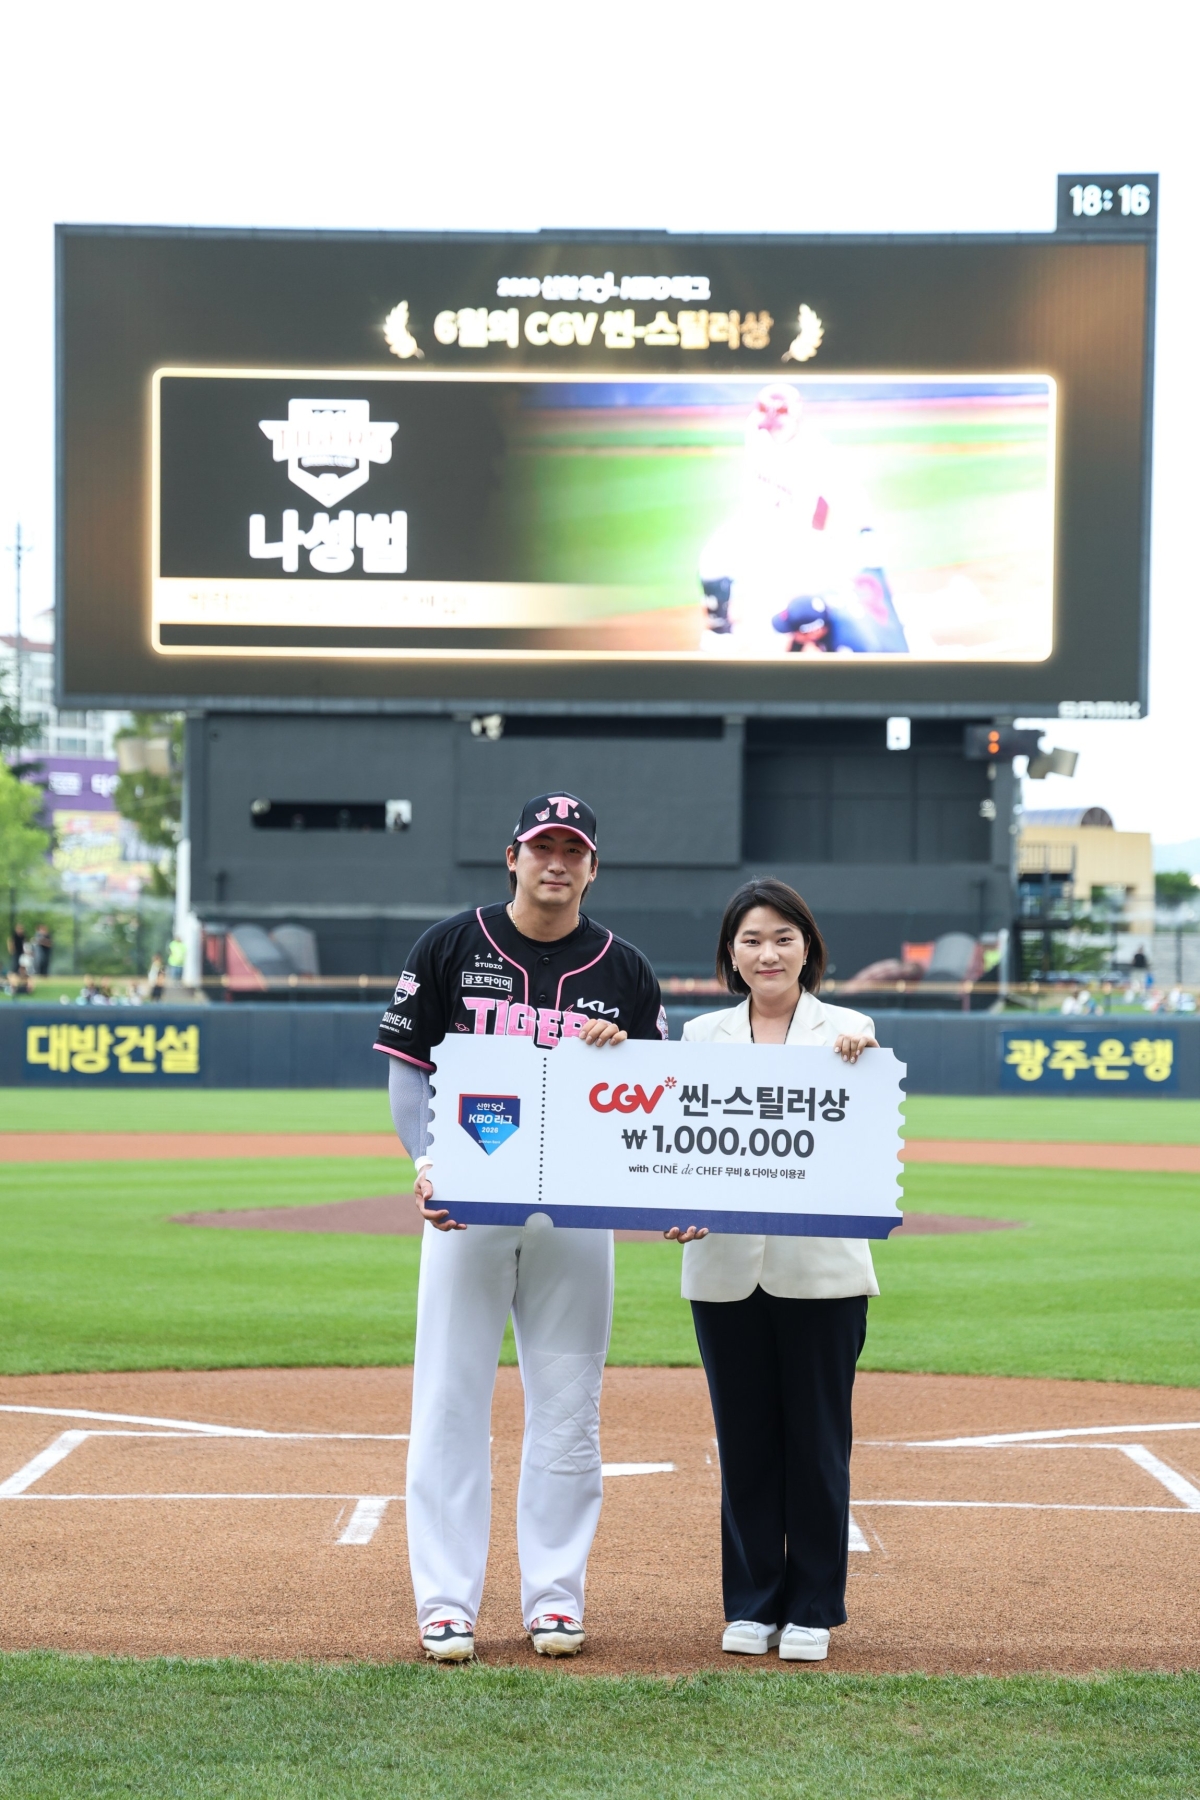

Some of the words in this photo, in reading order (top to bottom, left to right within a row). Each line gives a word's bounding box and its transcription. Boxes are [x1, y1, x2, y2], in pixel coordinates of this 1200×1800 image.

[1069, 184, 1151, 216] 18:16
[524, 310, 599, 346] CGV
[248, 508, 408, 574] 나성범
[463, 974, 511, 990] 금호타이어
[474, 961, 503, 970] STUDIO
[462, 996, 612, 1049] TIGER
[26, 1024, 200, 1074] 대방건설
[1004, 1038, 1174, 1083] 광주은행
[468, 1113, 494, 1124] KBO
[494, 1114, 513, 1125] 리그
[476, 1102, 490, 1111] 신한
[588, 1082, 665, 1114] CGV
[678, 1083, 850, 1122] 씬-스틸러상
[628, 1164, 649, 1173] with
[681, 1163, 694, 1175] de
[696, 1165, 724, 1176] CHEF
[725, 1166, 742, 1177] 무비
[743, 1168, 751, 1177] &
[752, 1168, 778, 1179] 다이닝
[780, 1169, 806, 1180] 이용권
